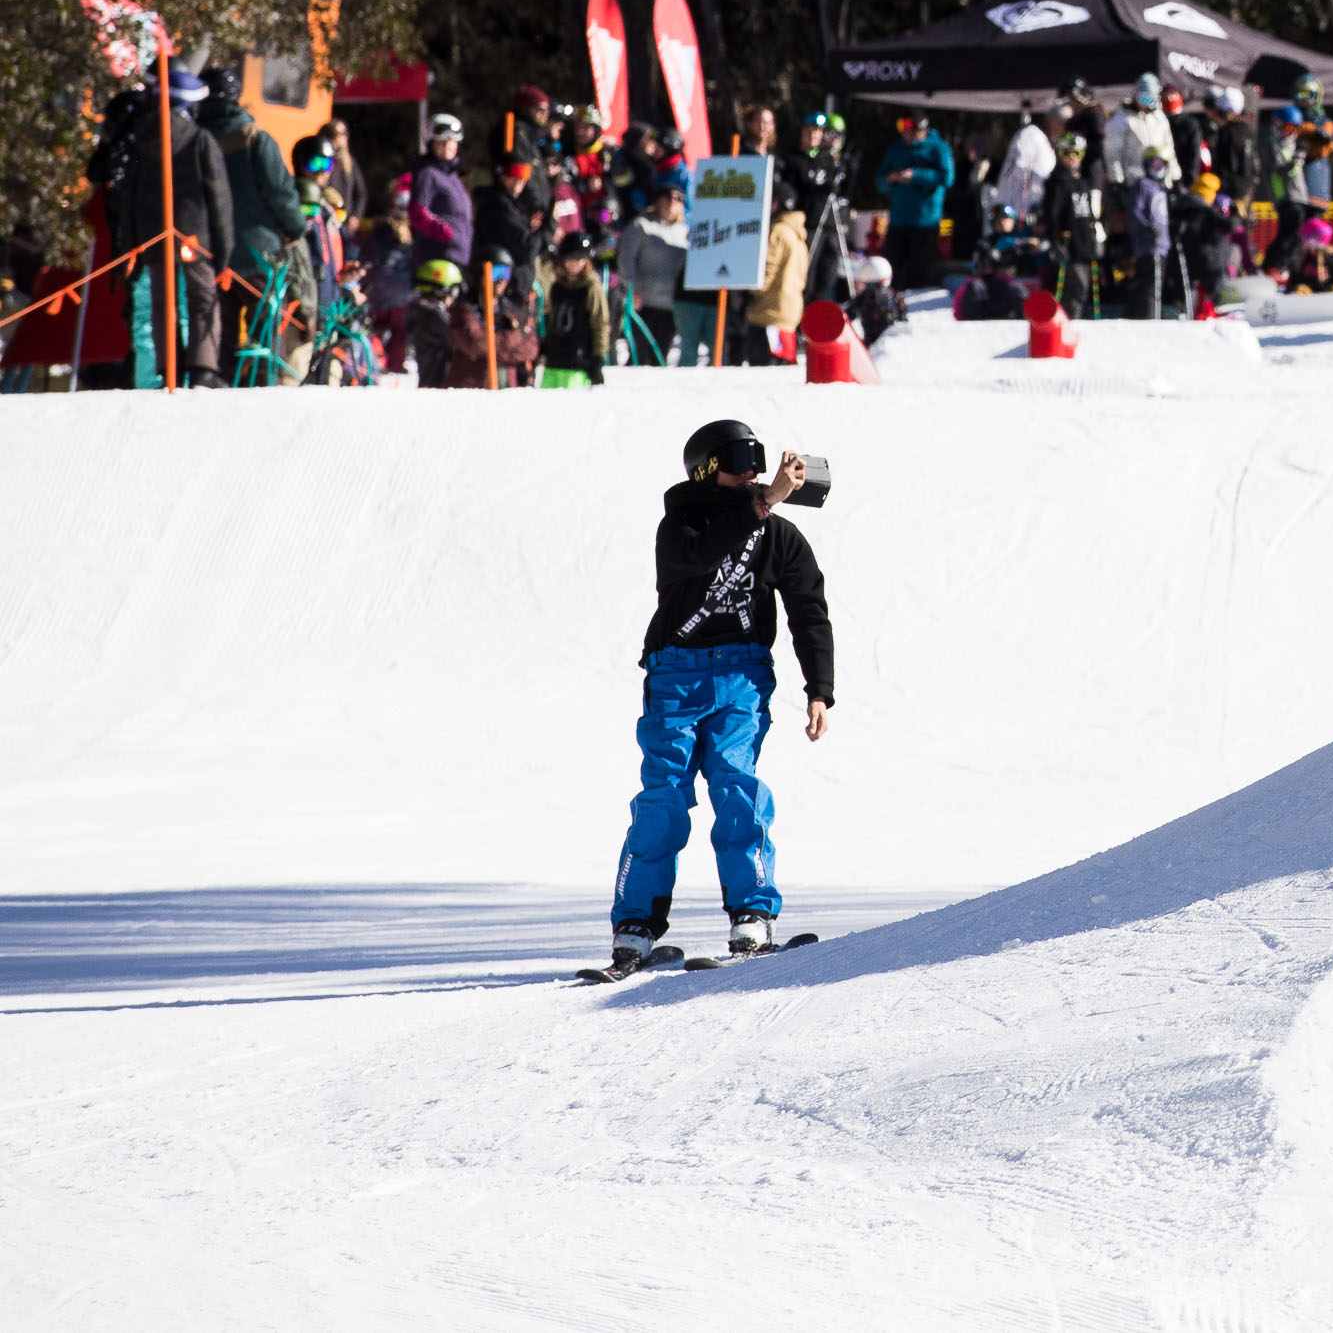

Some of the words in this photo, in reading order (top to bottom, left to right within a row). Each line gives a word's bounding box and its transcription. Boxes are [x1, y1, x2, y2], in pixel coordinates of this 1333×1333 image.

[864, 61, 924, 81] ROXY
[715, 564, 746, 601] Skier
[681, 614, 701, 634] am
[739, 609, 751, 630] am
